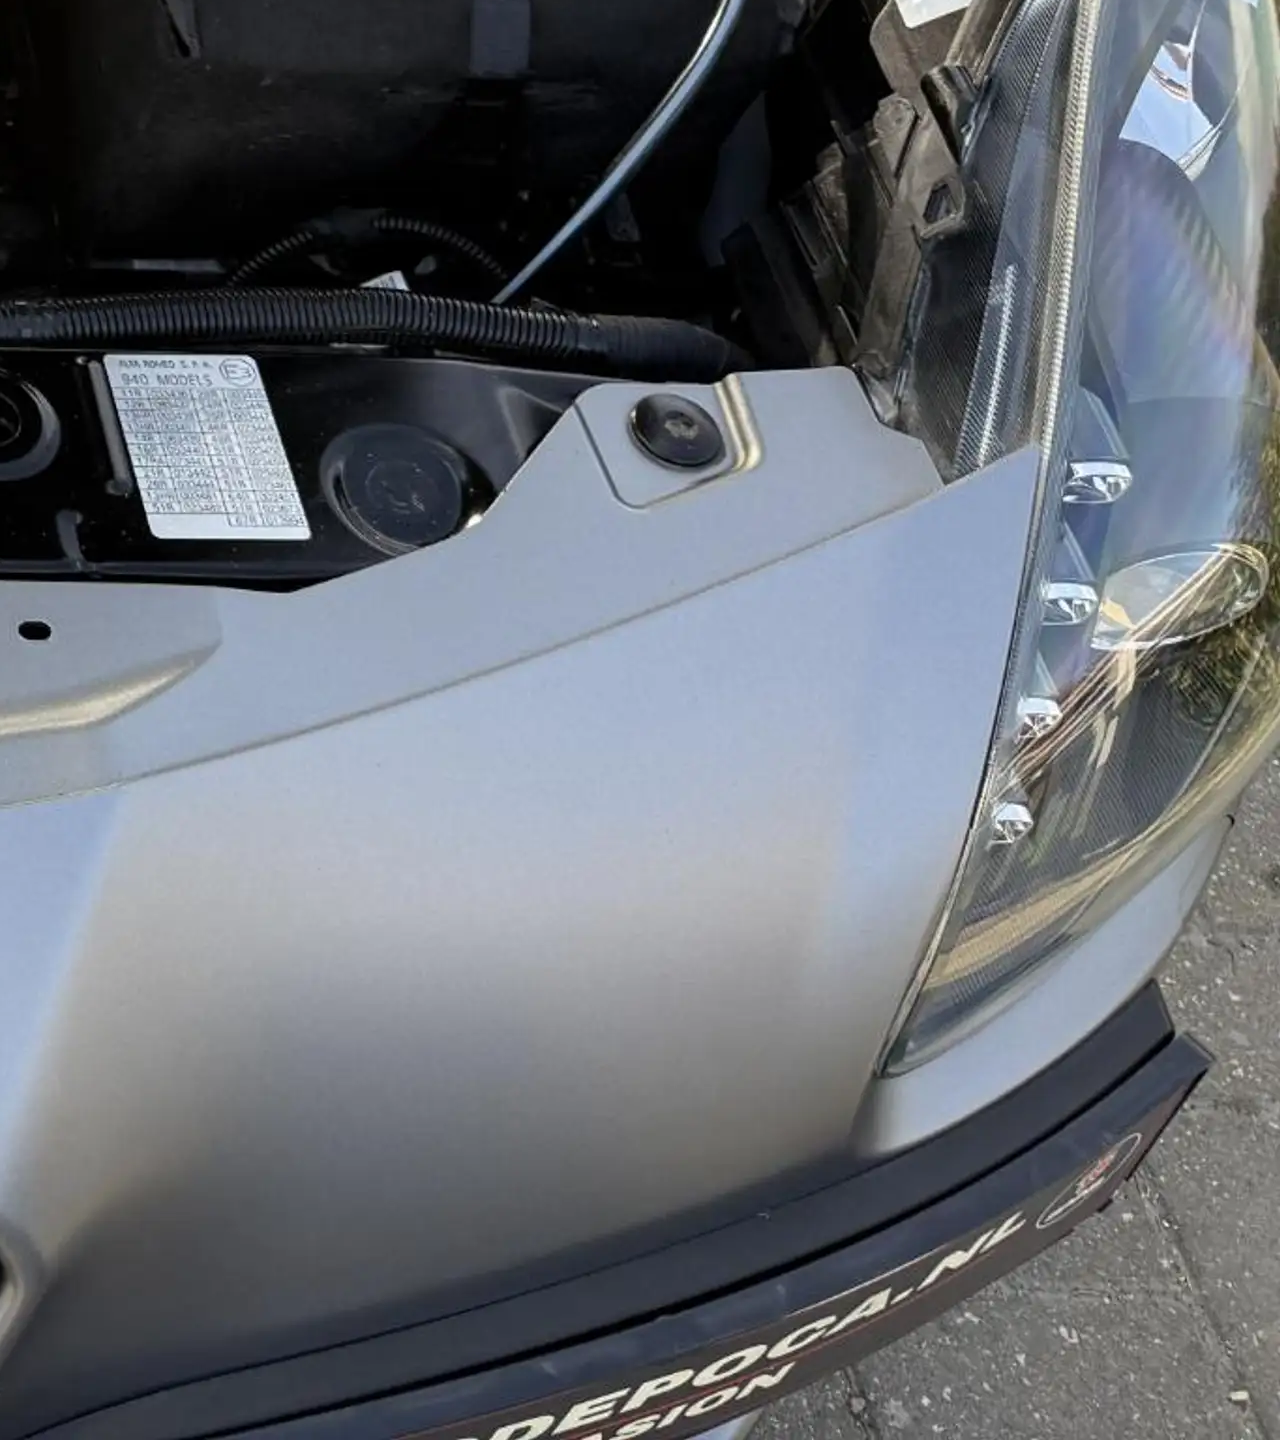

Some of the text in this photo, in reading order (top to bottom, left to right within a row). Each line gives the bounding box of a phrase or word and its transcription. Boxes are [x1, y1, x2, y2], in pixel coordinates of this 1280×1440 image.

[121, 373, 213, 386] 940 MODELS
[455, 1210, 1027, 1440] DEPOCA.NL
